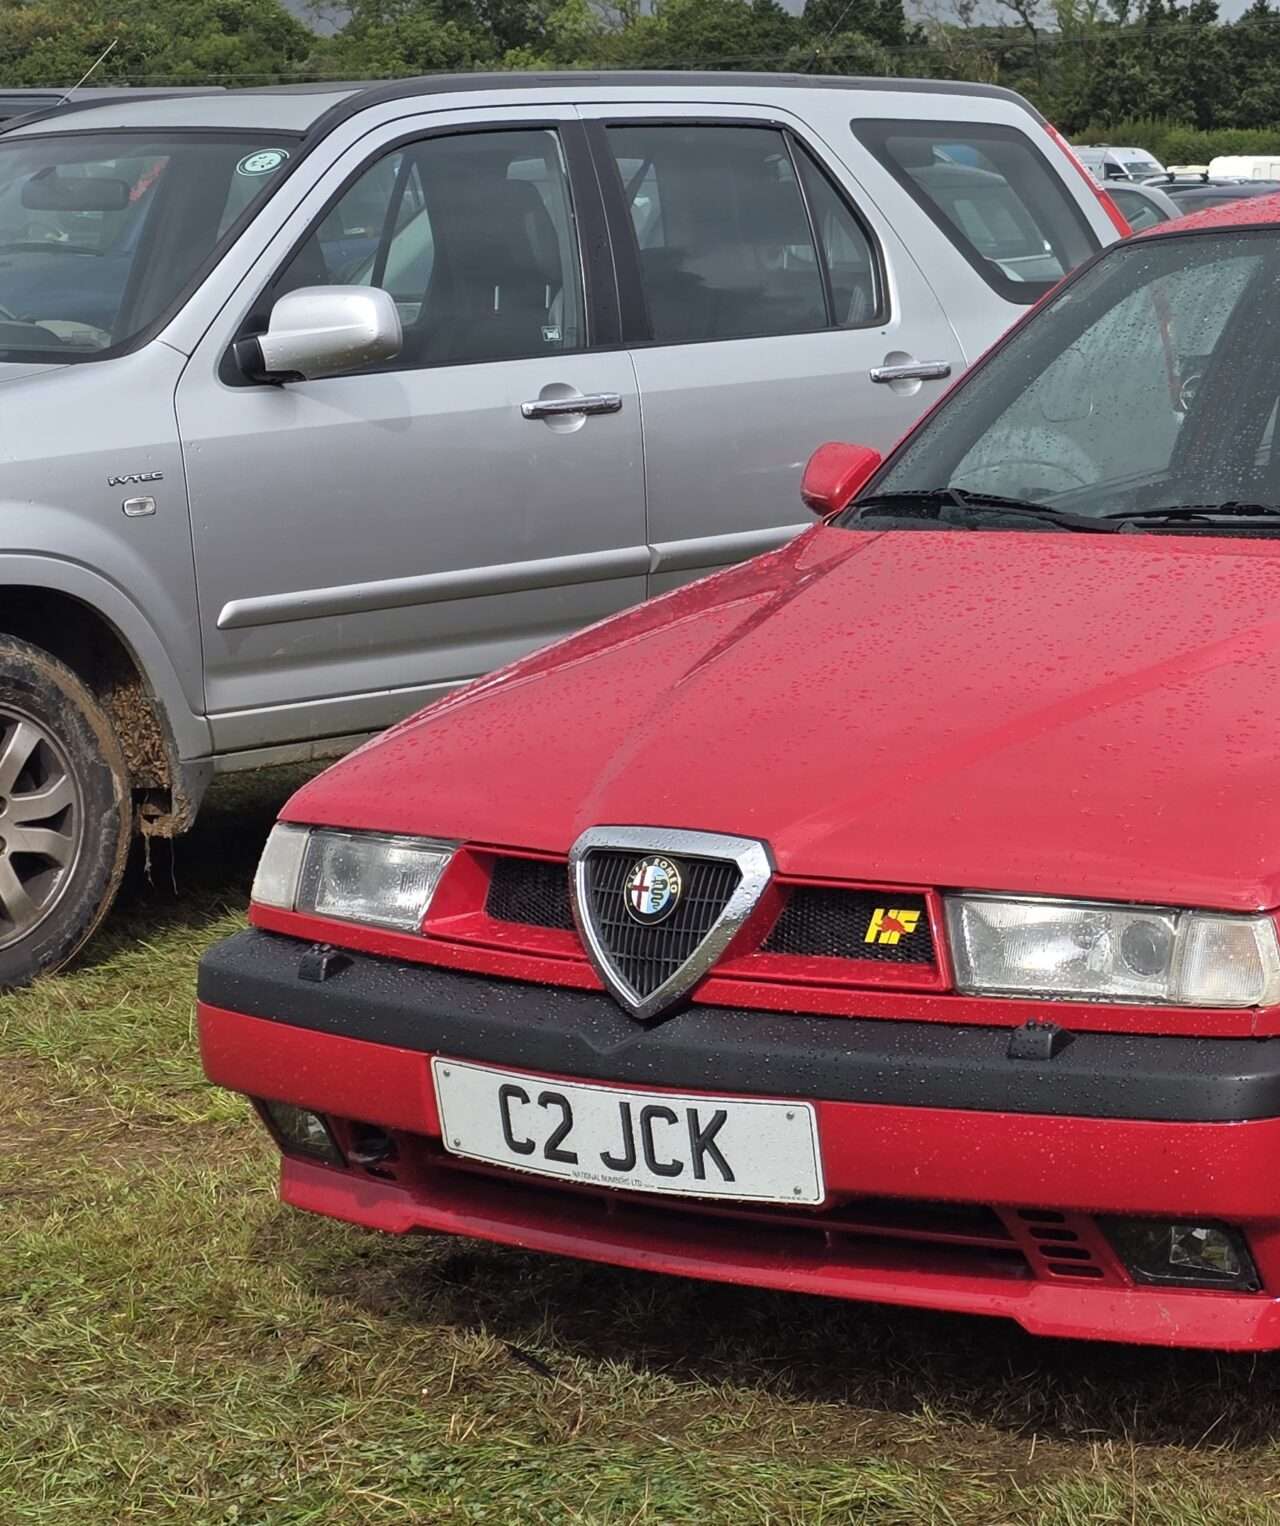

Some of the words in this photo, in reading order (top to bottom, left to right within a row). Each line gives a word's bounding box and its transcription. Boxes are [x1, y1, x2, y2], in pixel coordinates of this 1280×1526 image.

[653, 858, 678, 893] ROMEO
[498, 1083, 578, 1165] C2
[600, 1101, 735, 1183] JCK
